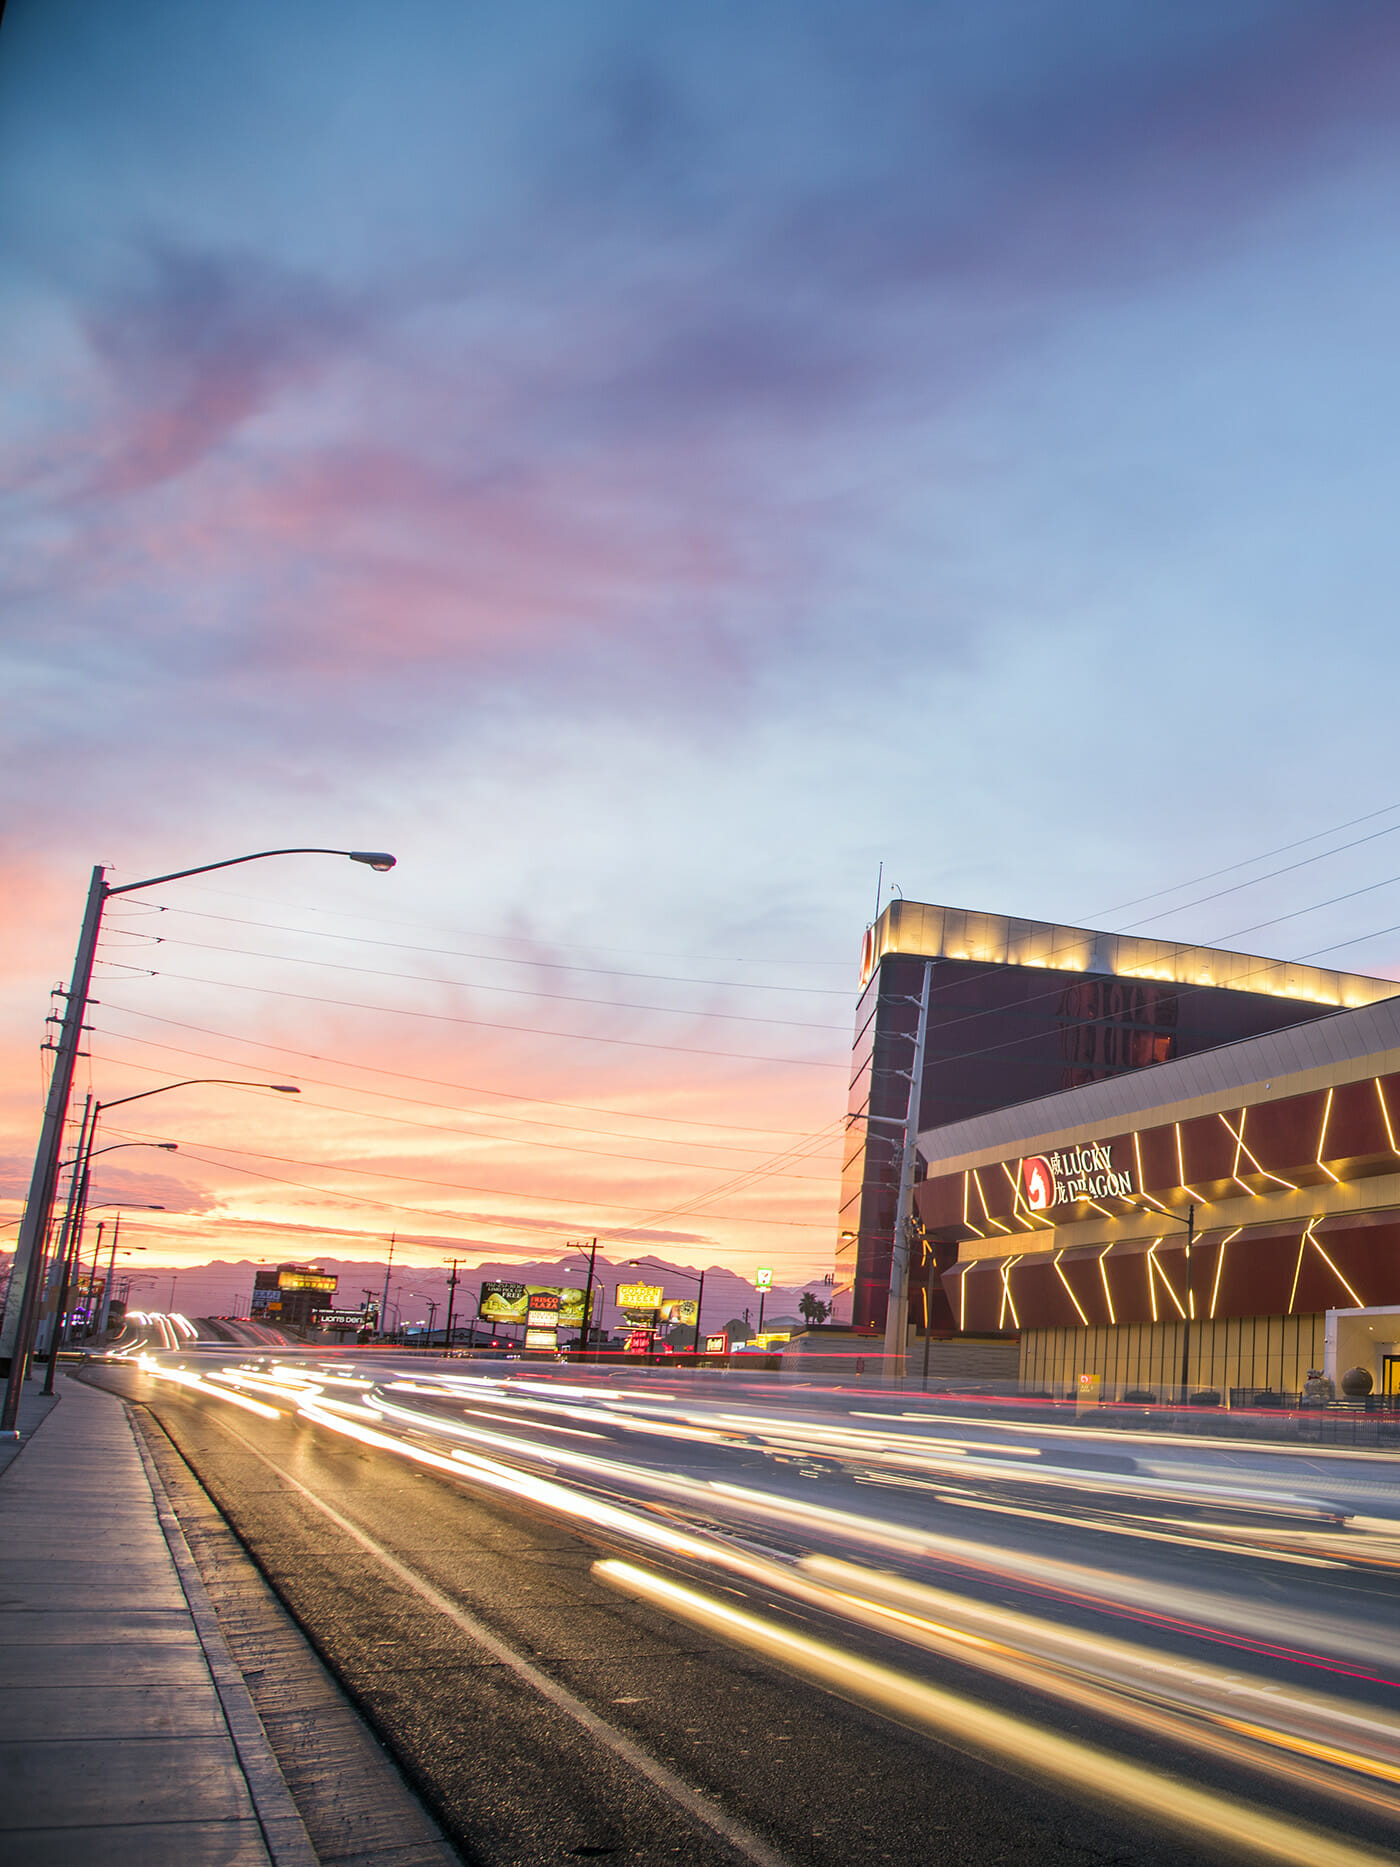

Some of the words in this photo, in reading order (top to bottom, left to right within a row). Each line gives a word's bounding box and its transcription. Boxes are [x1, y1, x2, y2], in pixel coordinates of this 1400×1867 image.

[1062, 1146, 1112, 1176] LUCKY
[1067, 1170, 1132, 1202] DRAGON
[621, 1287, 658, 1296] GOLDEN
[623, 1294, 655, 1302] STEER
